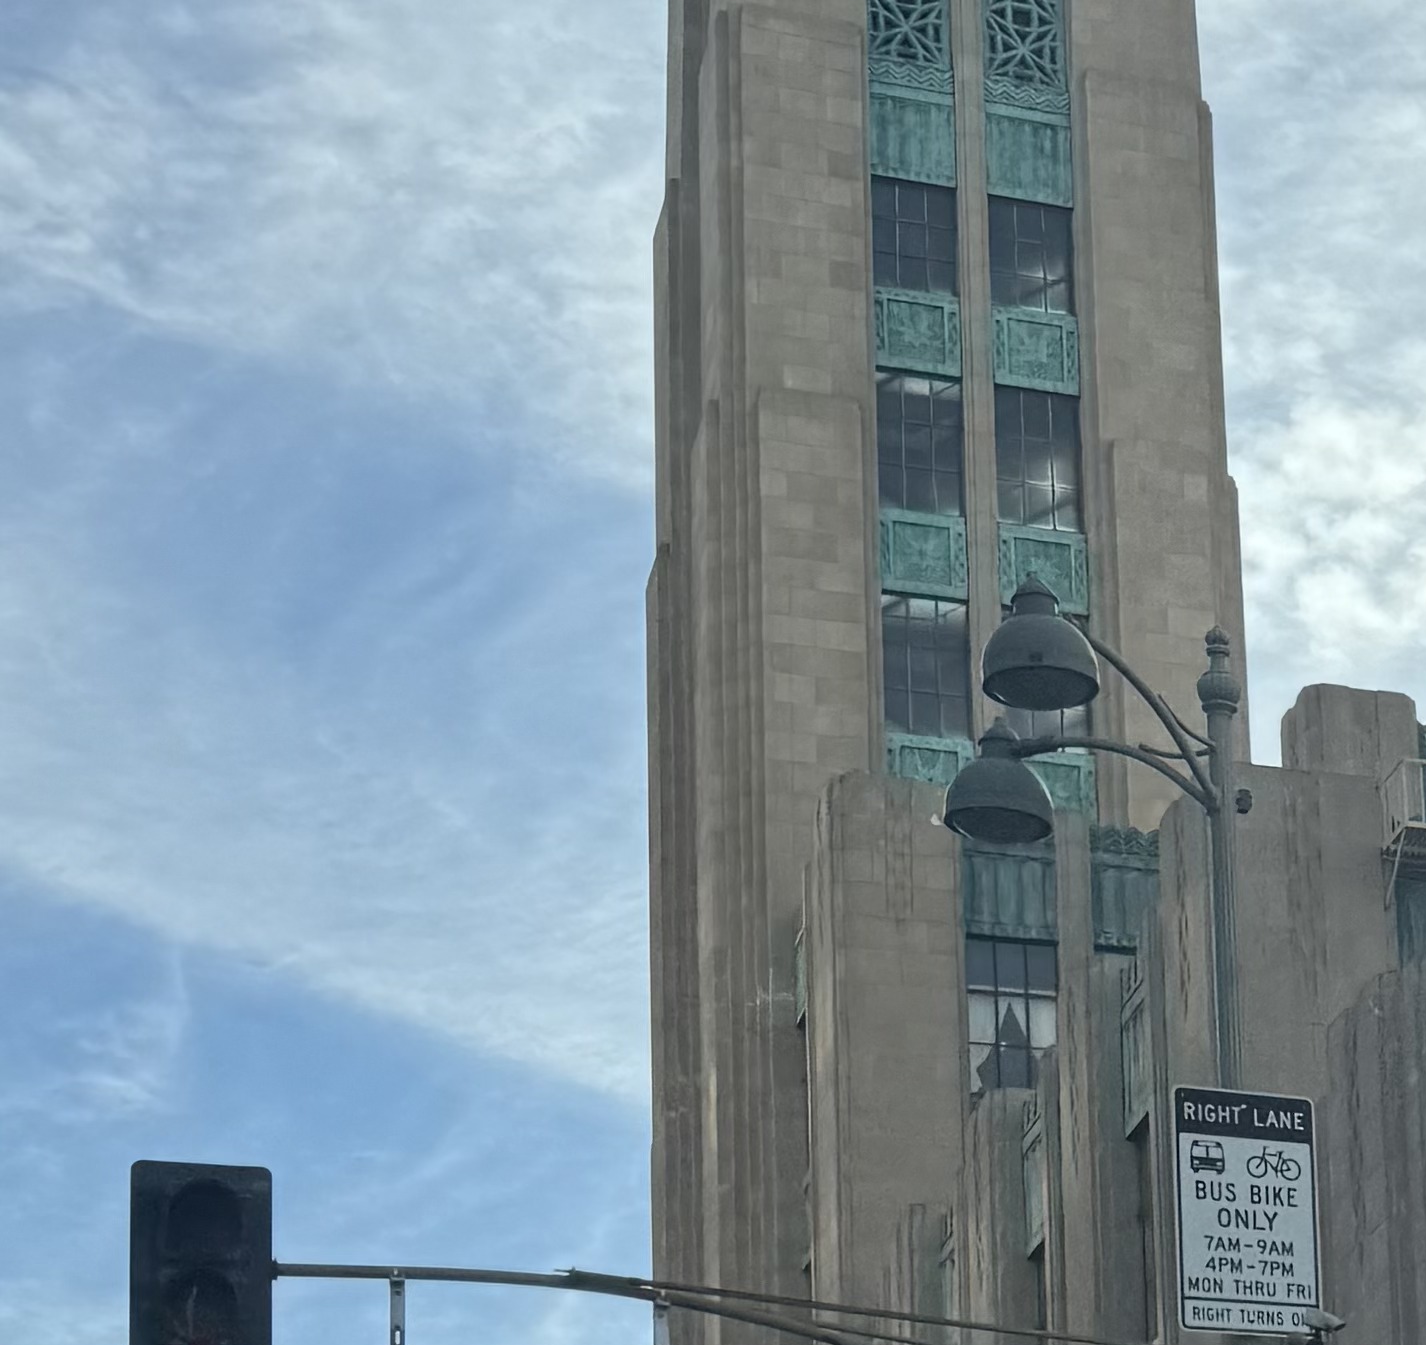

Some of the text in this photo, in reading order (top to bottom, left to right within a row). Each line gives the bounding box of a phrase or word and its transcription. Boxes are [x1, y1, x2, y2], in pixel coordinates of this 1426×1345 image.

[1183, 1101, 1305, 1131] RIGHT LANE
[1195, 1180, 1298, 1208] BUS BIKE
[1217, 1208, 1278, 1232] ONLY
[1204, 1235, 1294, 1257] 7AM-9AM
[1205, 1257, 1294, 1277] 4PM-7PM
[1188, 1276, 1312, 1300] MON THRU FRI
[1192, 1306, 1232, 1324] RIGHT
[1240, 1309, 1284, 1326] TURNS
